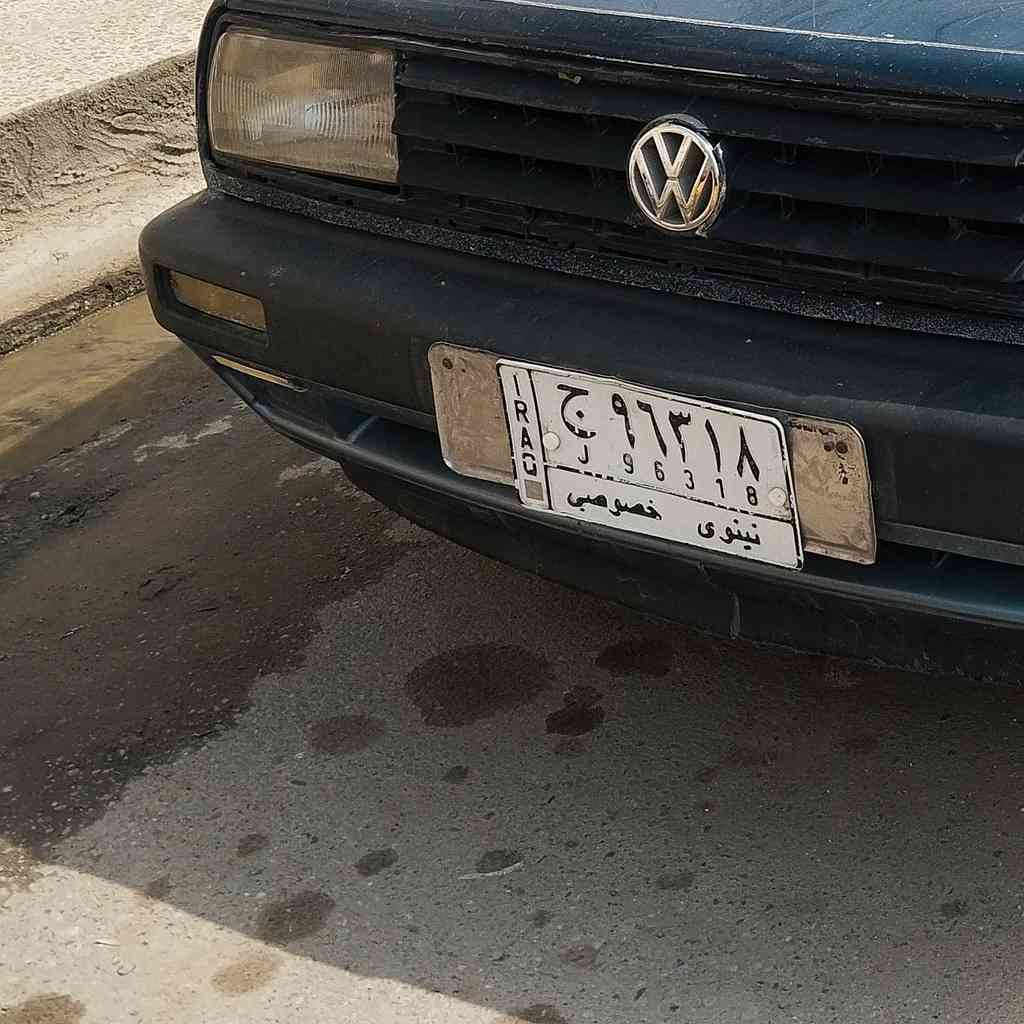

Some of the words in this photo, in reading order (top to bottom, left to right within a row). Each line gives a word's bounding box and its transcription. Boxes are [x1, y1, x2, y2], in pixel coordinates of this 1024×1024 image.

[512, 374, 537, 477] IRAQ
[557, 384, 596, 439] ج
[612, 393, 760, 482] ٩٦٣١٨
[622, 453, 758, 506] 96318
[698, 519, 761, 550] نينوى
